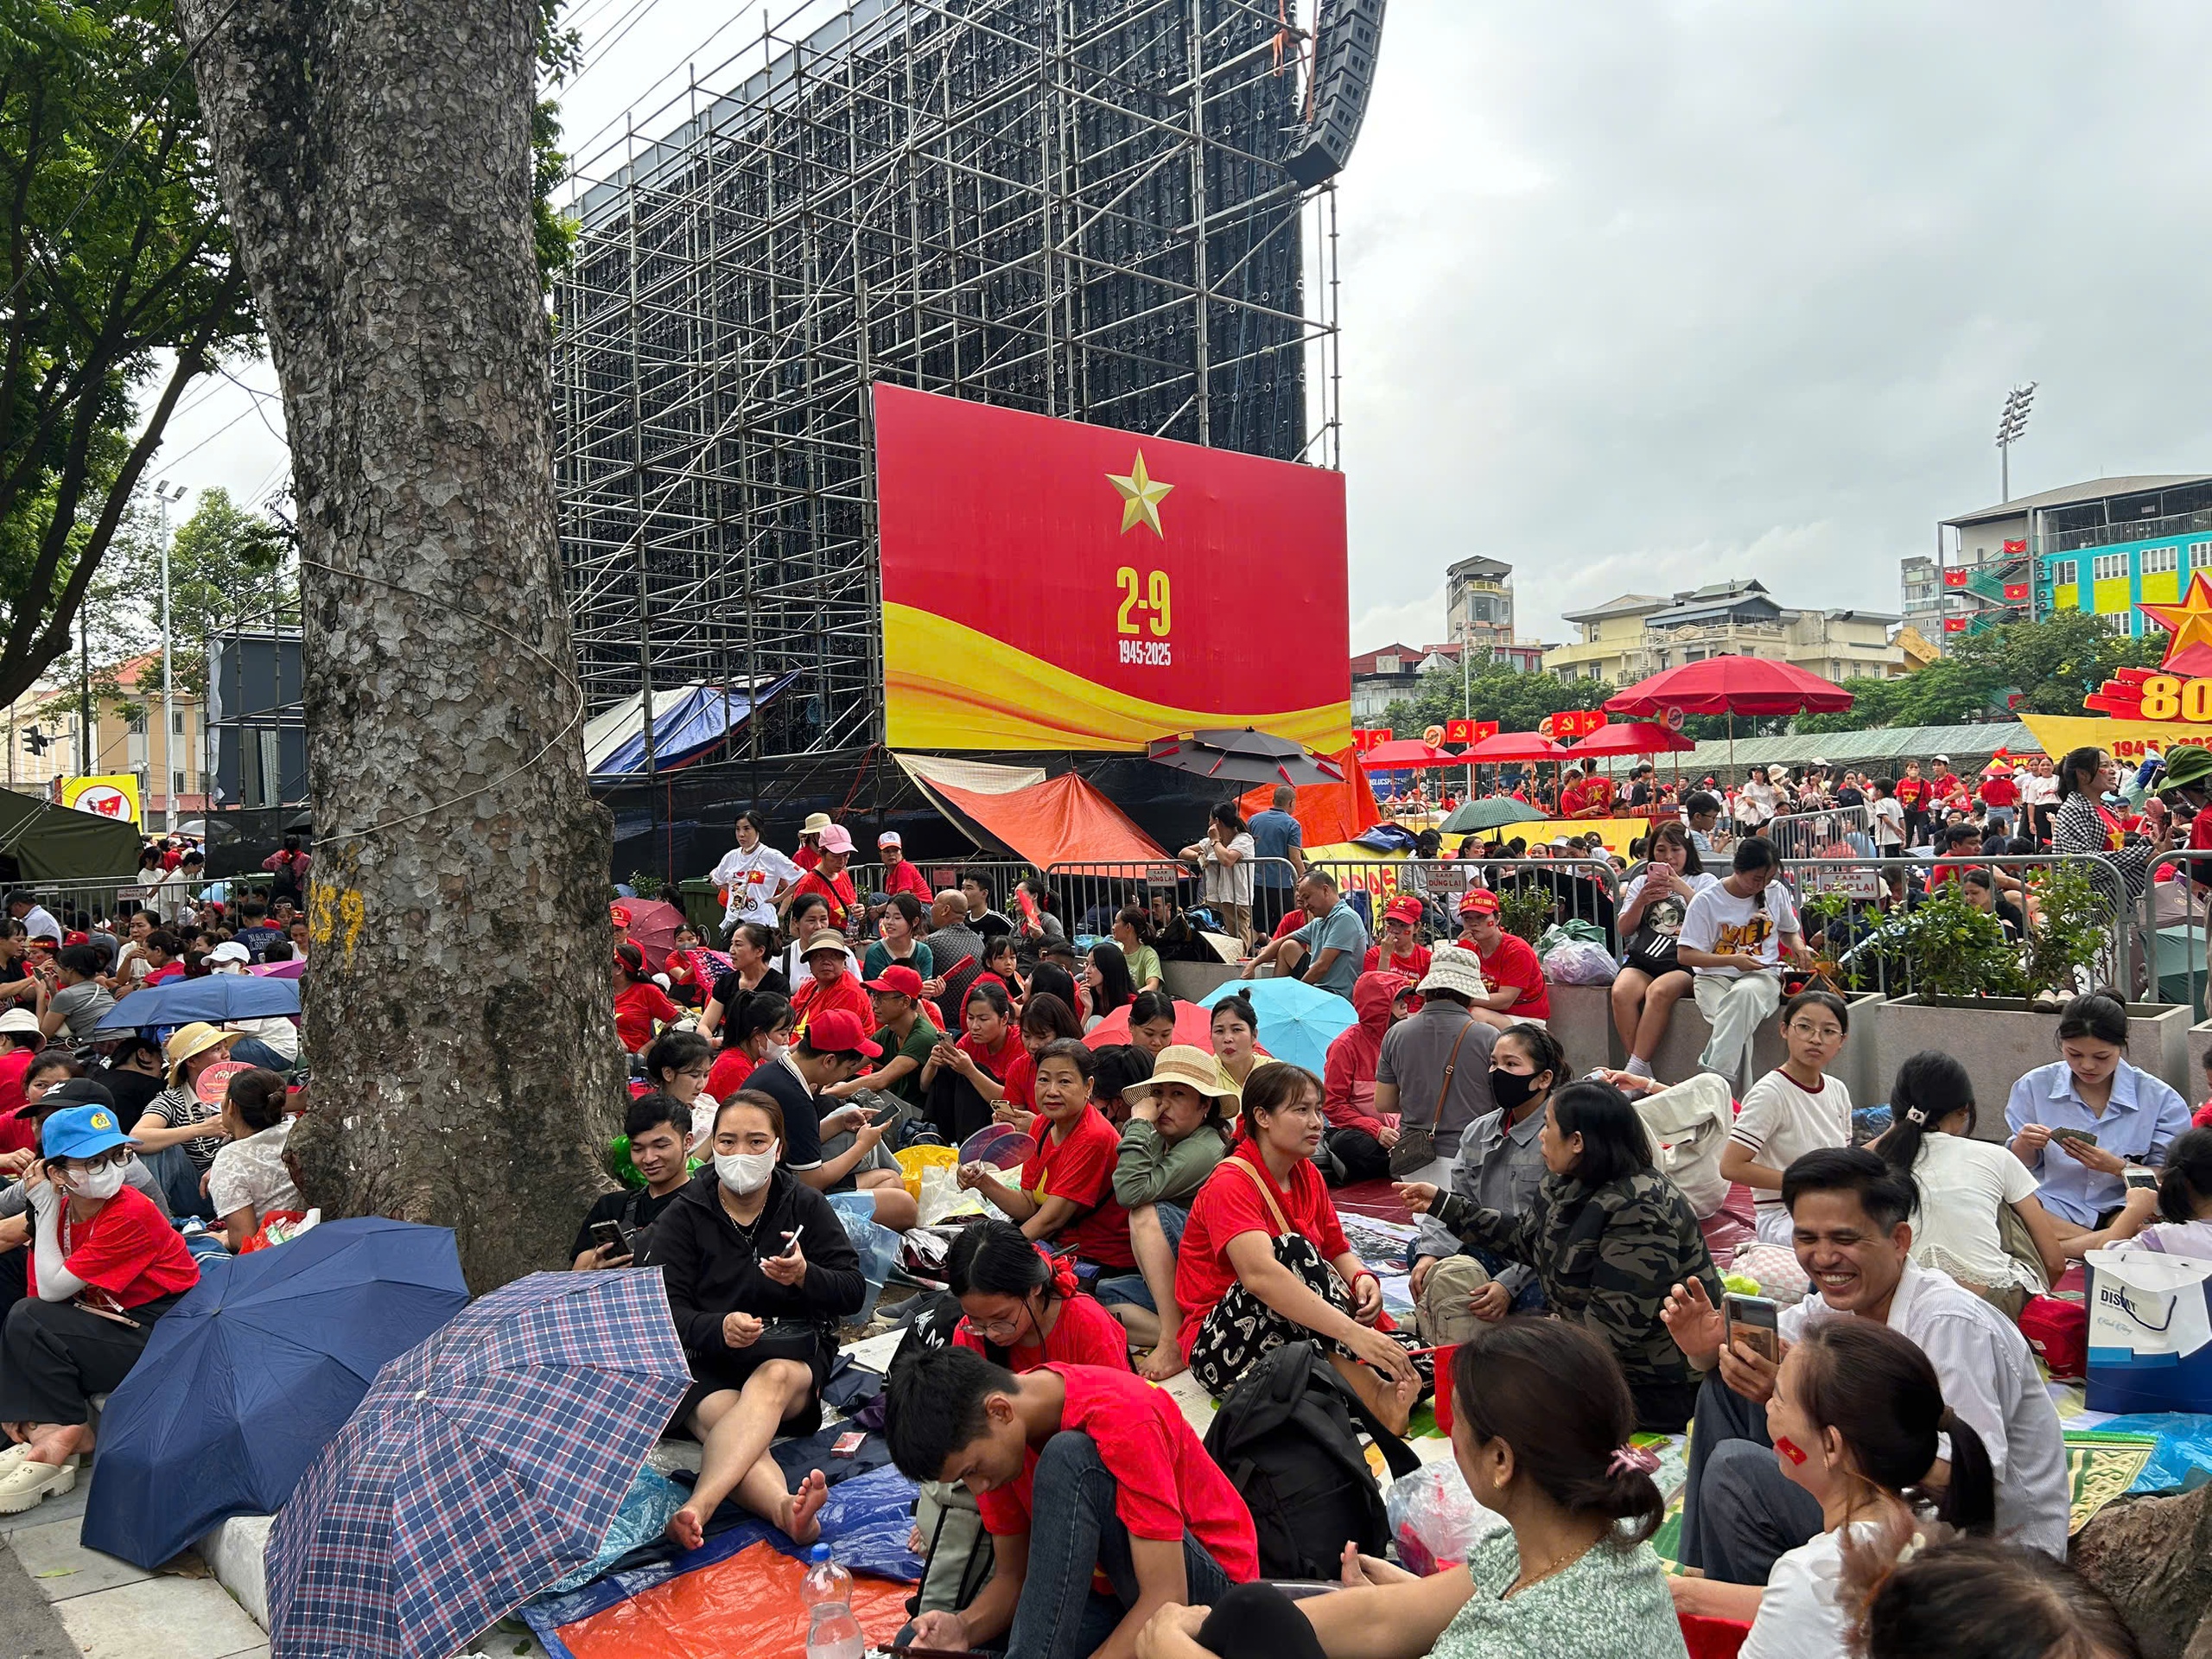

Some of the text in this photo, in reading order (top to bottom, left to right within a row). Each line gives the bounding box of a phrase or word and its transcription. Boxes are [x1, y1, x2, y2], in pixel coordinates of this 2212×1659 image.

[1116, 566, 1172, 637] 2-9
[1118, 639, 1172, 666] 1945-2025
[2140, 676, 2212, 722] 80
[2113, 739, 2160, 757] 1945
[1428, 877, 1461, 888] DỪNG LẠI
[1856, 883, 1874, 893] LẠI
